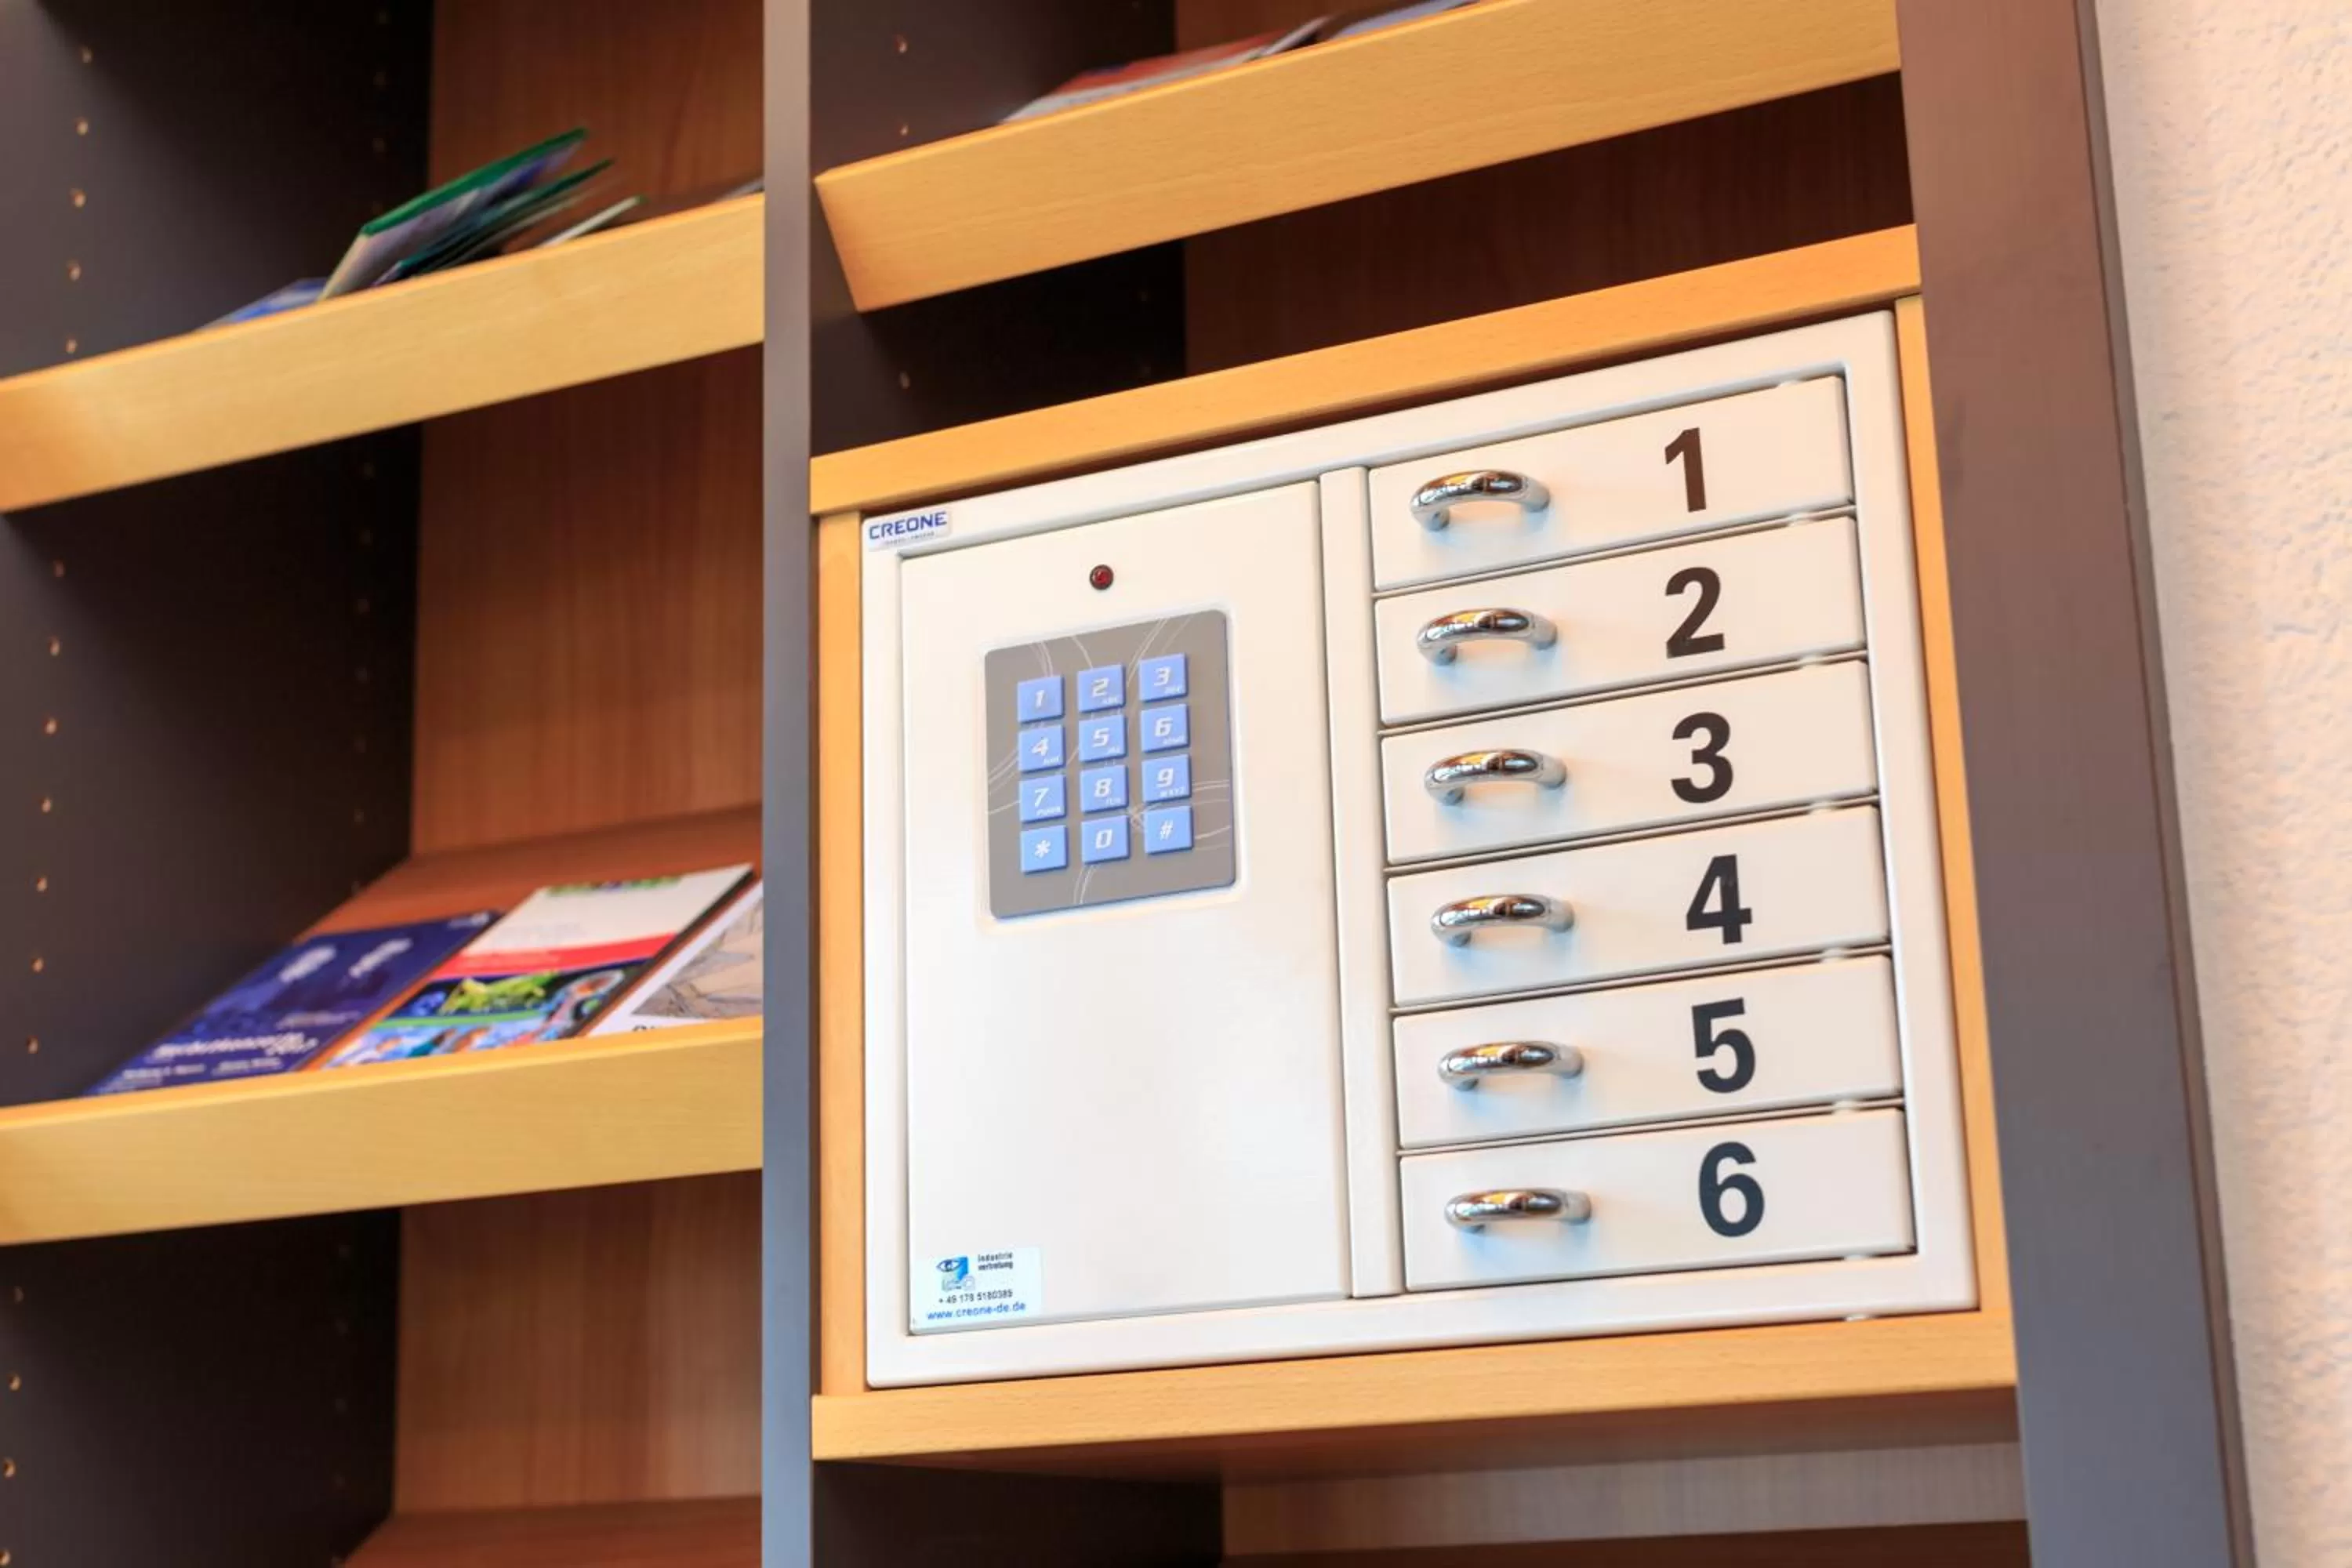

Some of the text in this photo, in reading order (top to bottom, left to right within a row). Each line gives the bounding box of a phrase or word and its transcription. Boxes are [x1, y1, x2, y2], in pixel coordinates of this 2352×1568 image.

[1664, 427, 1707, 513] 1
[869, 511, 947, 540] CREONE
[1664, 567, 1725, 659] 2
[1153, 666, 1171, 687] 3
[1091, 677, 1110, 698] 2
[1035, 689, 1045, 709] 1
[1092, 727, 1110, 748] 5
[1154, 717, 1174, 737] 6
[1031, 737, 1049, 757] 4
[1670, 711, 1734, 803] 3
[1094, 777, 1113, 798] 8
[1156, 768, 1174, 789] 9
[1034, 786, 1050, 808] 7
[1094, 828, 1113, 849] 0
[1686, 854, 1753, 945] 4
[1691, 996, 1756, 1094] 5
[1697, 1141, 1766, 1238] 6
[946, 1294, 957, 1304] 49
